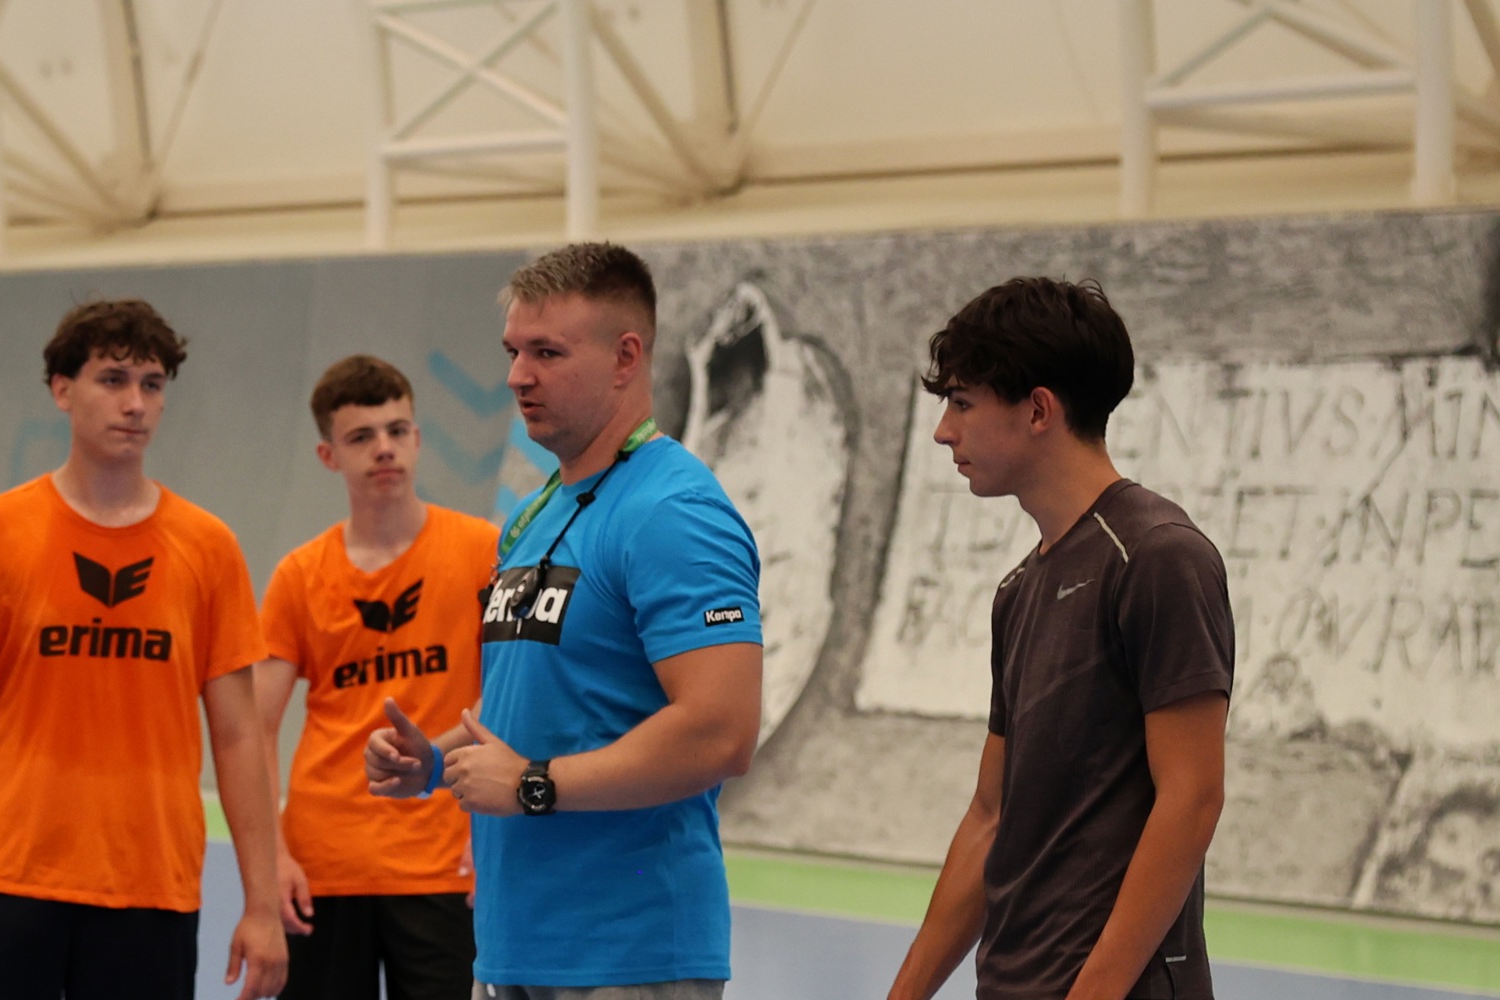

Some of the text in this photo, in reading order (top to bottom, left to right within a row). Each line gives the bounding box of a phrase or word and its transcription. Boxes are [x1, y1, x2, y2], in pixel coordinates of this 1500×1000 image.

[705, 609, 743, 623] Kempa
[38, 617, 173, 664] erima
[333, 643, 448, 690] erima
